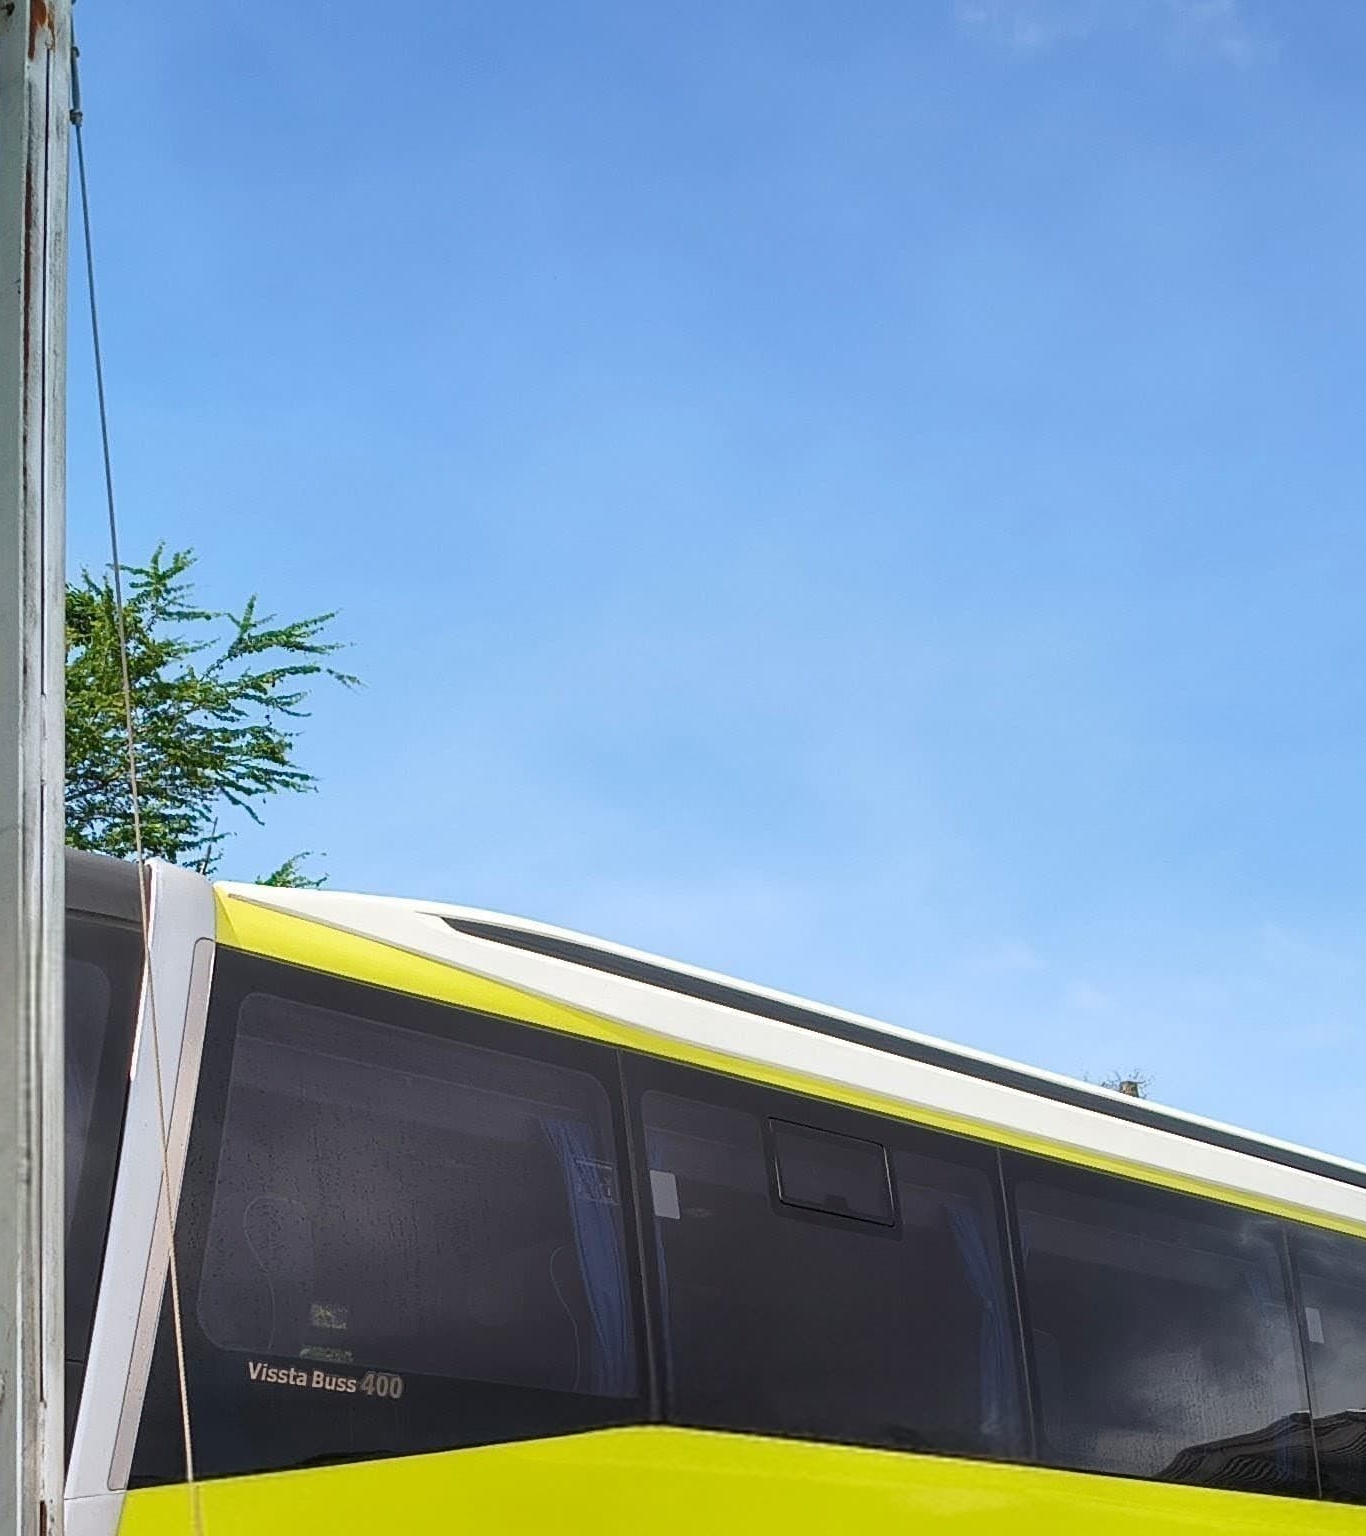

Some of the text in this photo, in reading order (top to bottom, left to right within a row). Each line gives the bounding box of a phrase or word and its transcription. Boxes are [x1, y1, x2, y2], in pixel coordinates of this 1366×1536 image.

[248, 1362, 403, 1400] Vissta Buss 400
